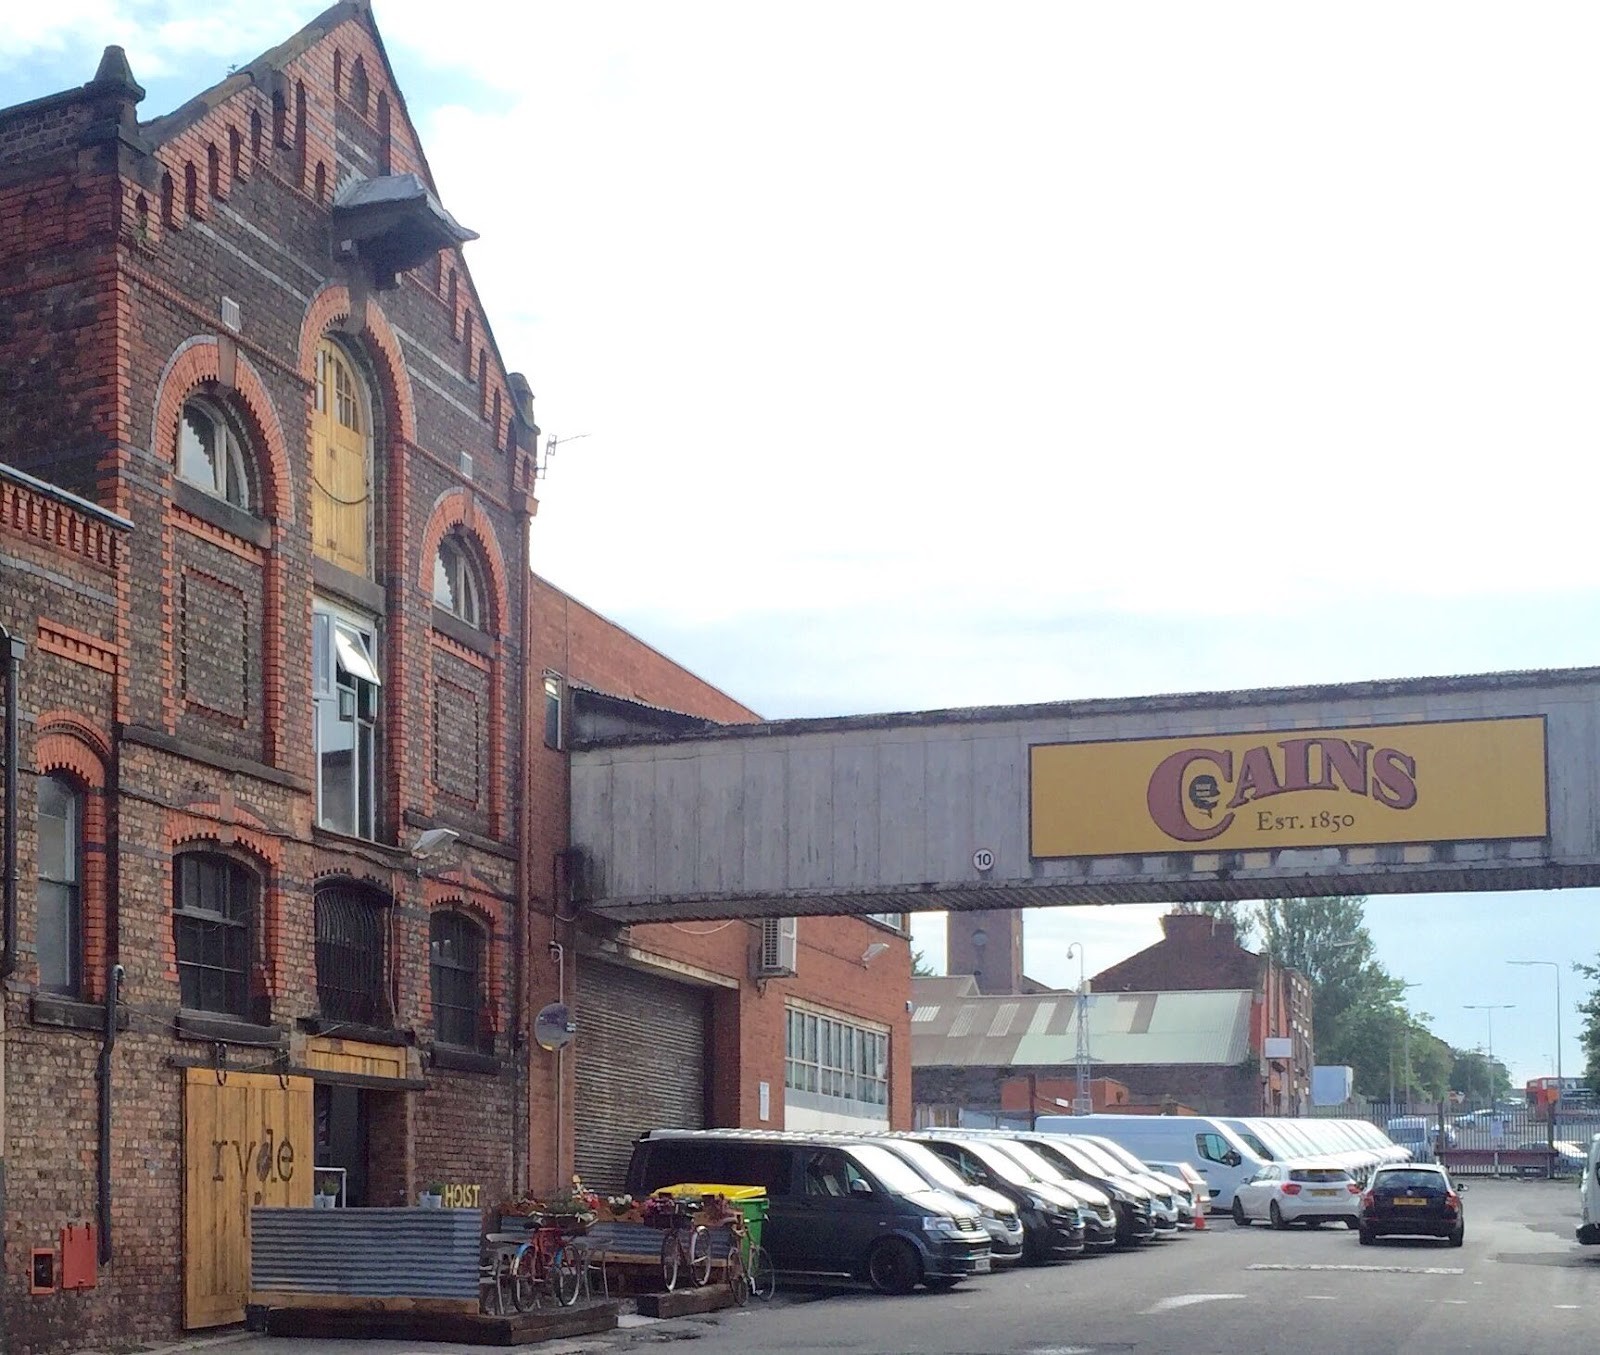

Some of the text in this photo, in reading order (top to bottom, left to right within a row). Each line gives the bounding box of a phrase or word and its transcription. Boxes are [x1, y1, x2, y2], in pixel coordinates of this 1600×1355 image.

[1147, 737, 1417, 842] CAINS
[1310, 810, 1355, 833] 1850
[976, 853, 991, 866] 10
[212, 1128, 294, 1193] ryde
[445, 1184, 480, 1208] HOIST
